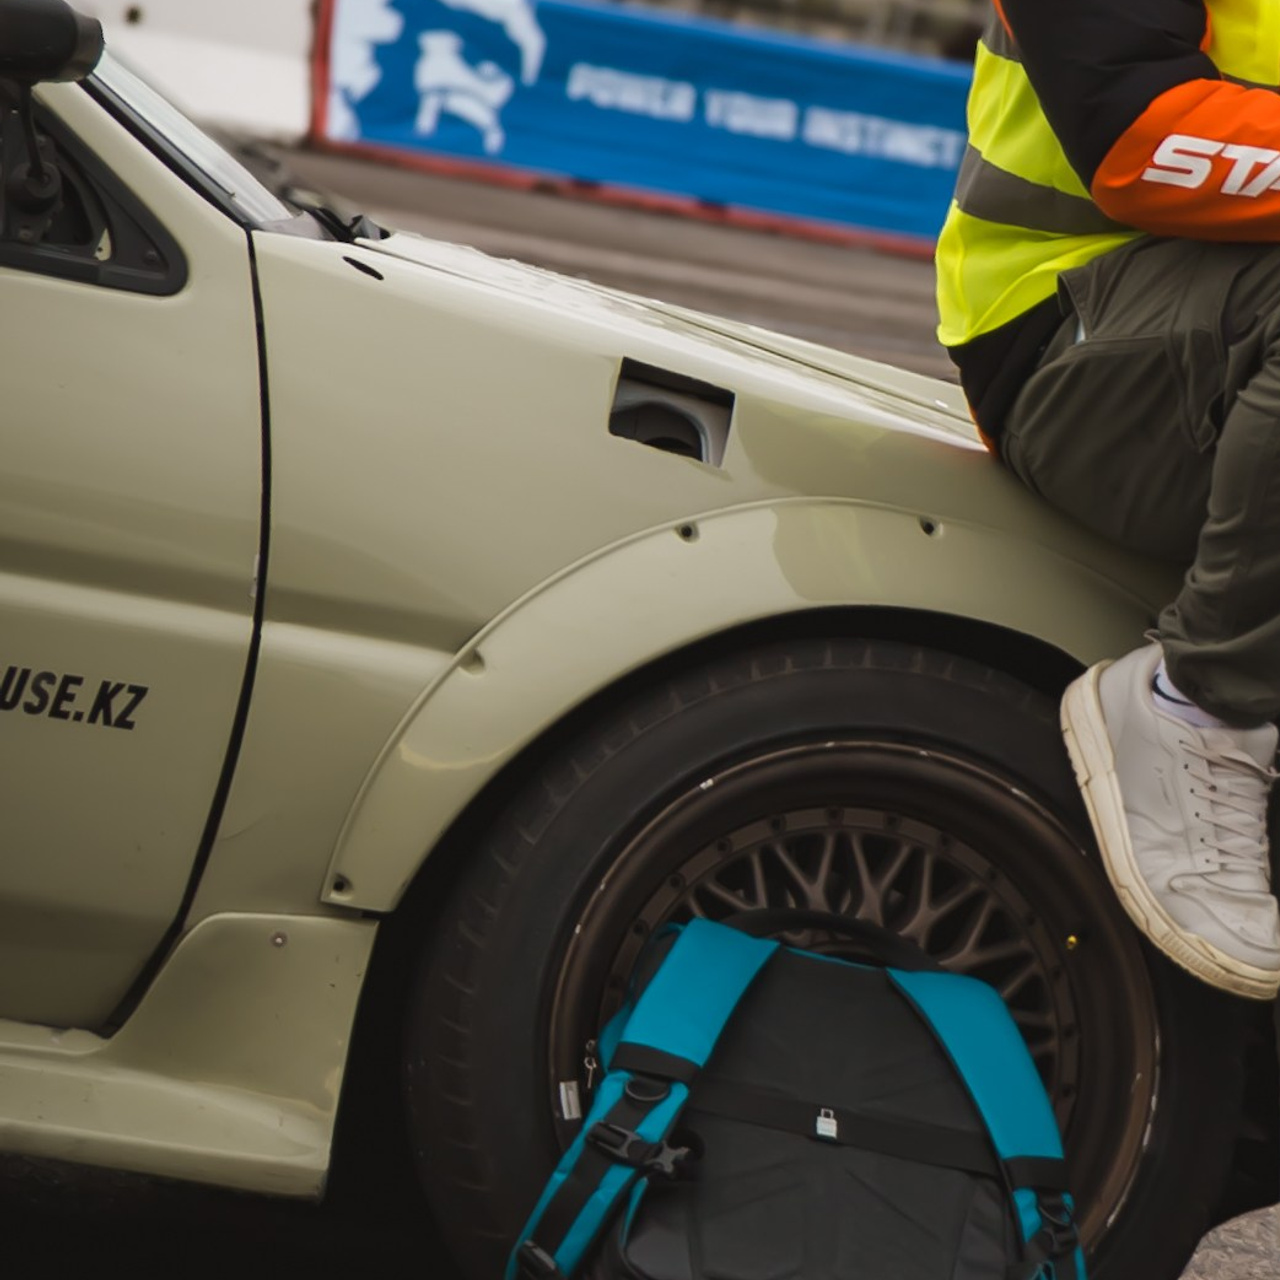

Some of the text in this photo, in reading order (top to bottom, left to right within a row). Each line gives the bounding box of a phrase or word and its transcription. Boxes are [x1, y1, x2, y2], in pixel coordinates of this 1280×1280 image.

[567, 62, 696, 122] POWER
[704, 89, 798, 141] YOUR
[0, 666, 149, 730] USE.KZ
